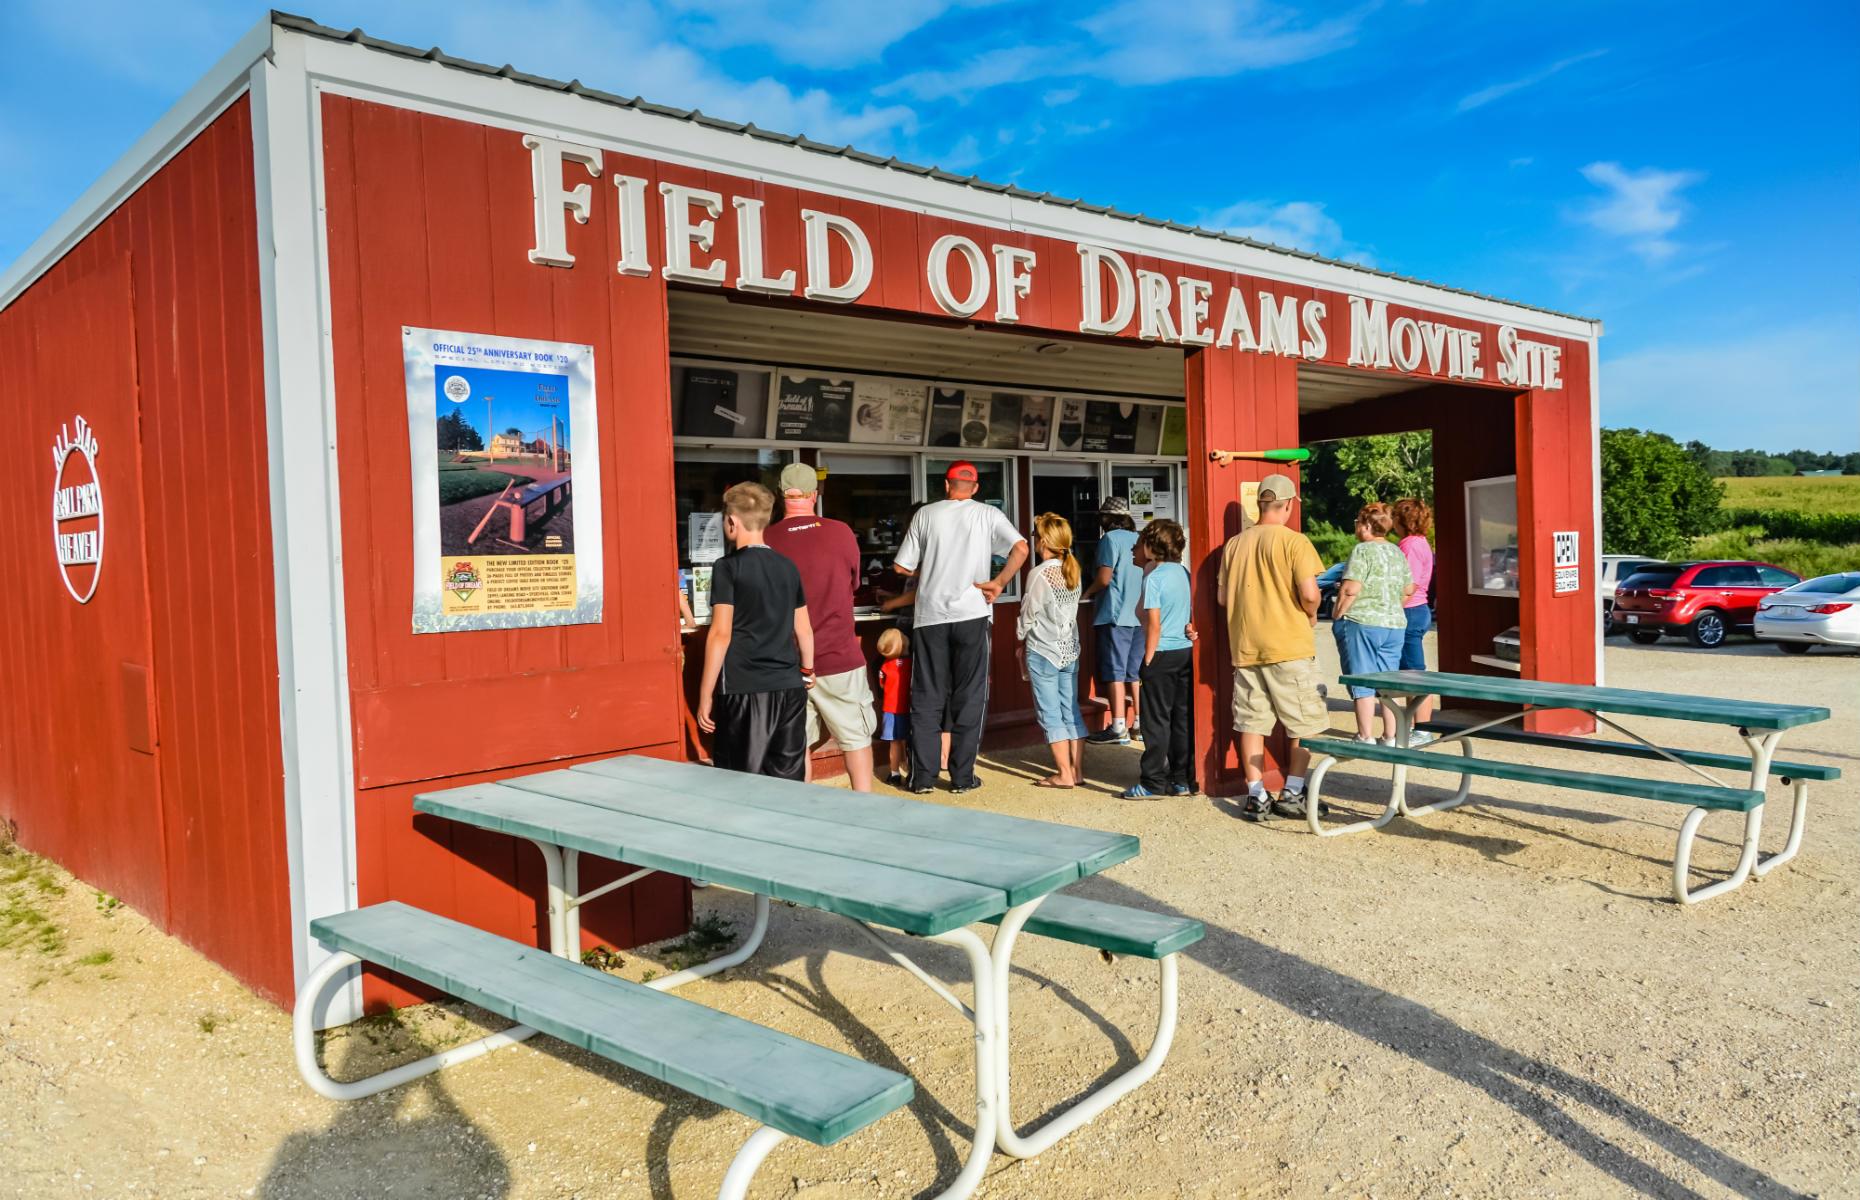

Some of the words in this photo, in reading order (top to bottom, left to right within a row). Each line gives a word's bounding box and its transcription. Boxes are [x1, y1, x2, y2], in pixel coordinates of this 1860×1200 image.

[522, 134, 874, 303] FIELD
[926, 234, 1037, 324] OF
[1076, 243, 1327, 361] DREAMS
[1347, 295, 1484, 381] MOVIE
[1497, 325, 1562, 390] SITE
[433, 343, 465, 355] OFFICIAL
[483, 347, 532, 361] ANNIVERSARY
[534, 352, 553, 363] BOOK
[53, 423, 72, 471] ALL
[73, 415, 98, 467] STAR
[59, 531, 98, 563] HEAVEN
[1556, 534, 1577, 563] OPEN
